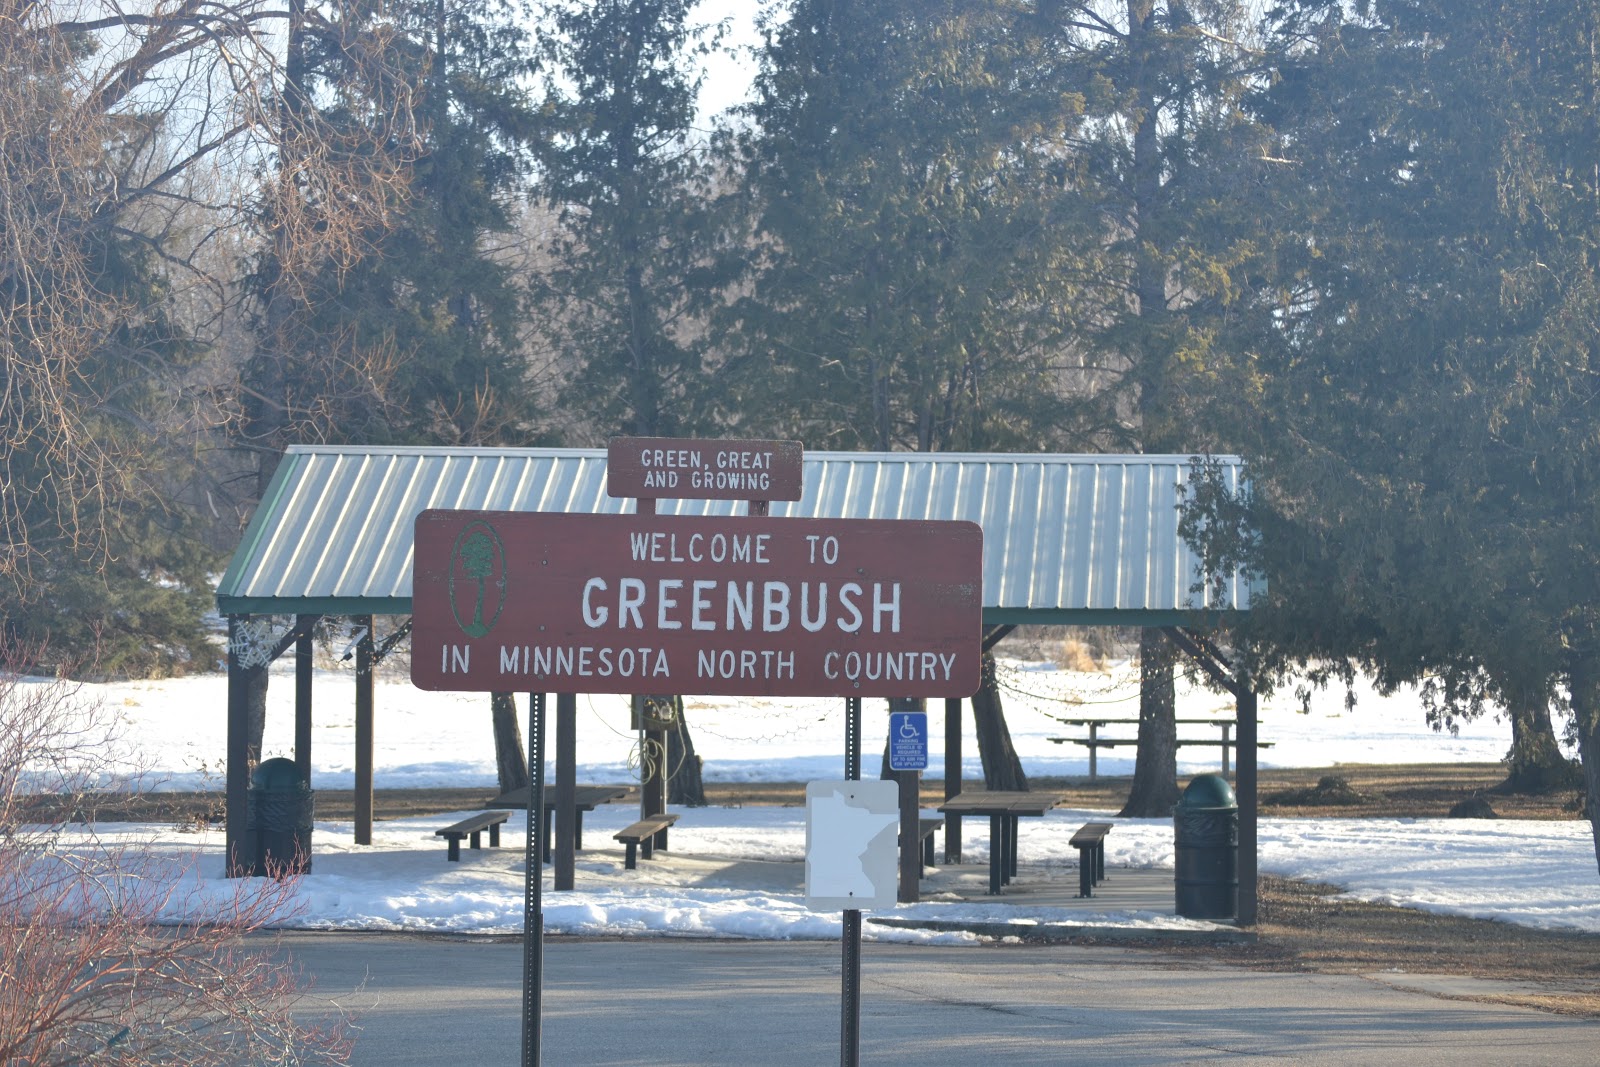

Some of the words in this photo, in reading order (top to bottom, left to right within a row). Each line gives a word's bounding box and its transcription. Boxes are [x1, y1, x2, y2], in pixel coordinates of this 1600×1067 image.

[641, 448, 709, 470] GREEN,
[717, 451, 773, 469] GREAT
[644, 471, 678, 488] AND
[691, 471, 770, 490] GROWING
[630, 532, 771, 564] WELCOME
[806, 535, 839, 565] TO
[582, 576, 902, 633] GREENBUSH
[441, 644, 470, 674] IN
[499, 645, 670, 678] MINNESOTA
[697, 650, 795, 679] NORTH
[824, 651, 956, 682] COUNTRY
